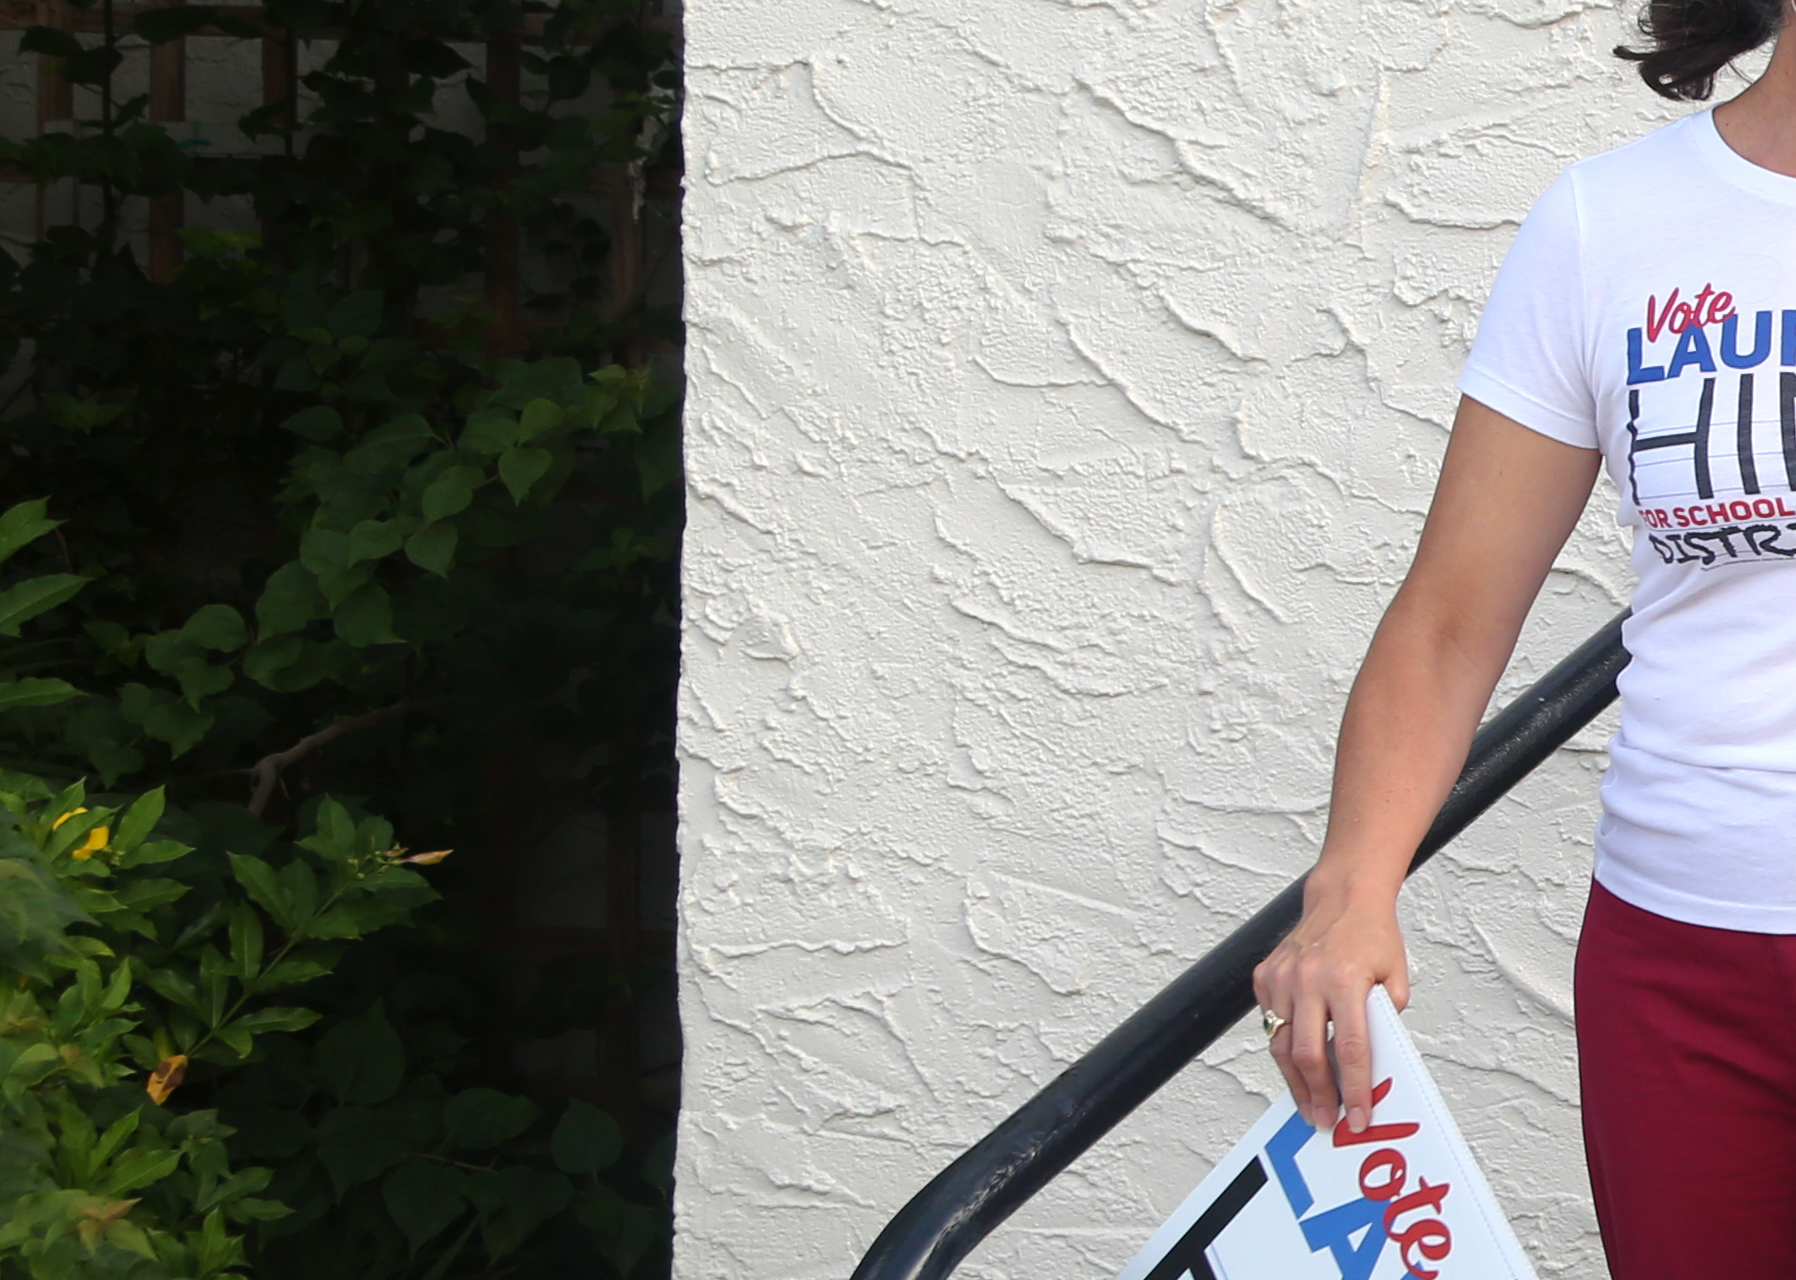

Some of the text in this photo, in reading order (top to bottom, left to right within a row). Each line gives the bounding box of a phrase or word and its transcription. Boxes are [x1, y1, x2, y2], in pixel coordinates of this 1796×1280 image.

[1647, 282, 1736, 343] Vote
[1677, 497, 1795, 528] SCHOOL
[1333, 1077, 1451, 1280] Vote
